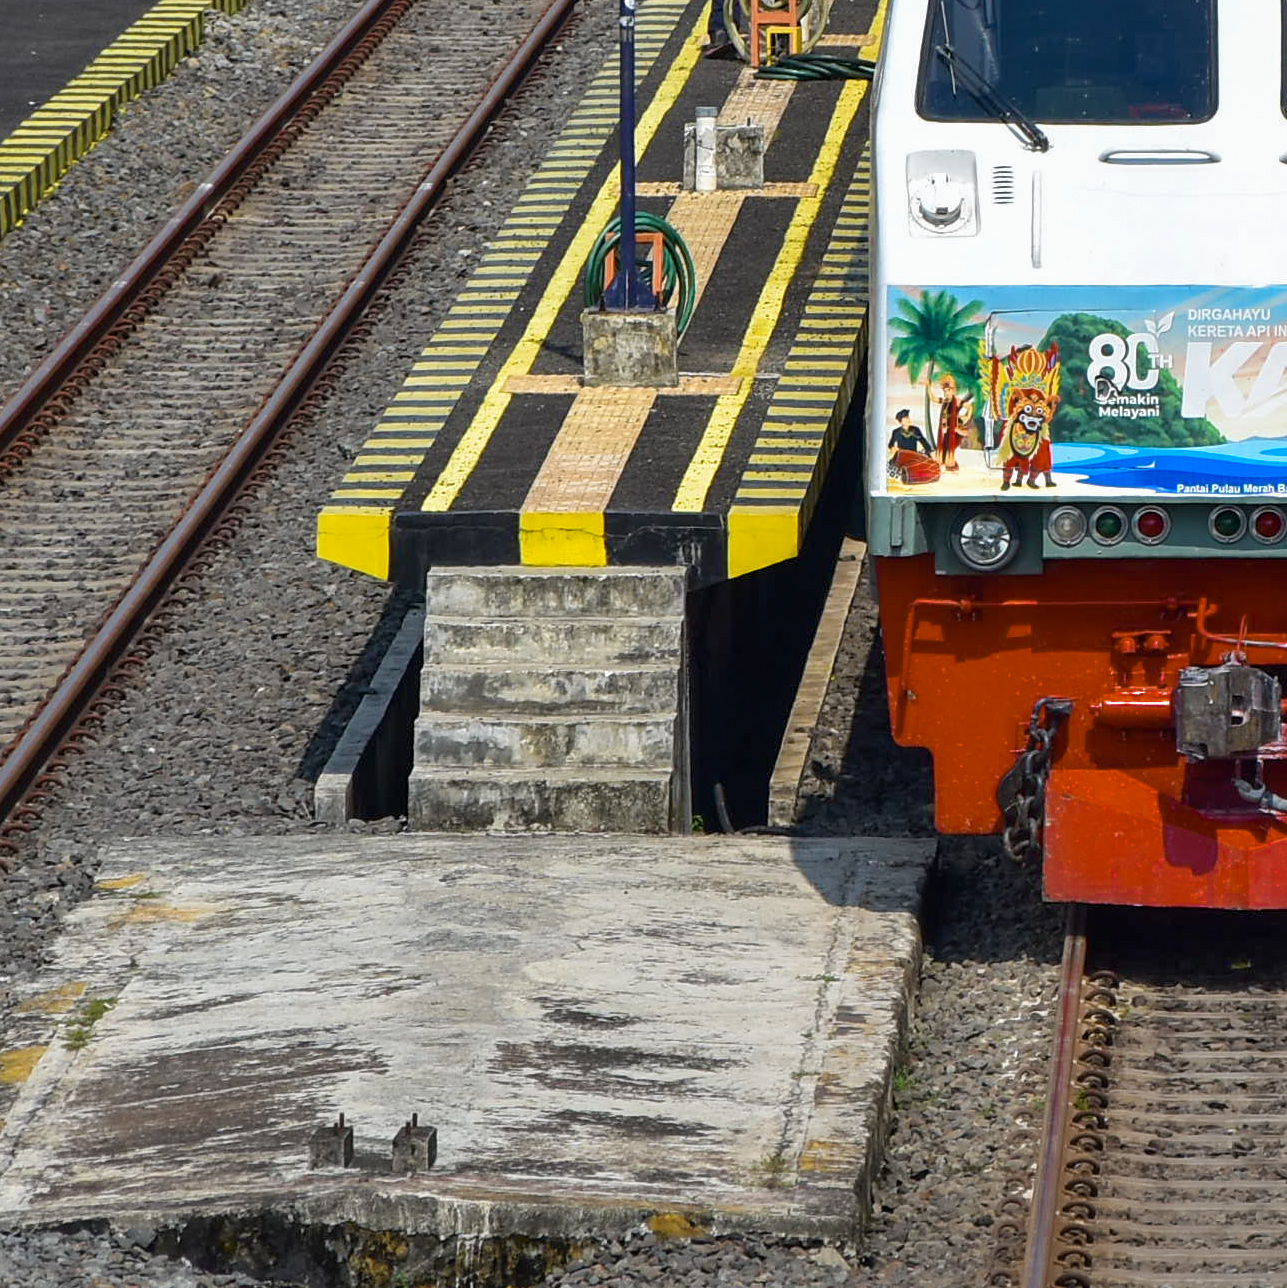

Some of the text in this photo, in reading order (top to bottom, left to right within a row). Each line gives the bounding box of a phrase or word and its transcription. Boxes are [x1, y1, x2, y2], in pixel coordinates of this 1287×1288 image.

[1187, 307, 1272, 322] DIRGAHAYU
[1187, 324, 1244, 338] KERETA
[1248, 324, 1271, 338] API
[1098, 405, 1160, 420] Melayani
[1176, 483, 1209, 494] Pantai
[1211, 483, 1241, 494] Pulau
[1243, 483, 1275, 494] Merah
